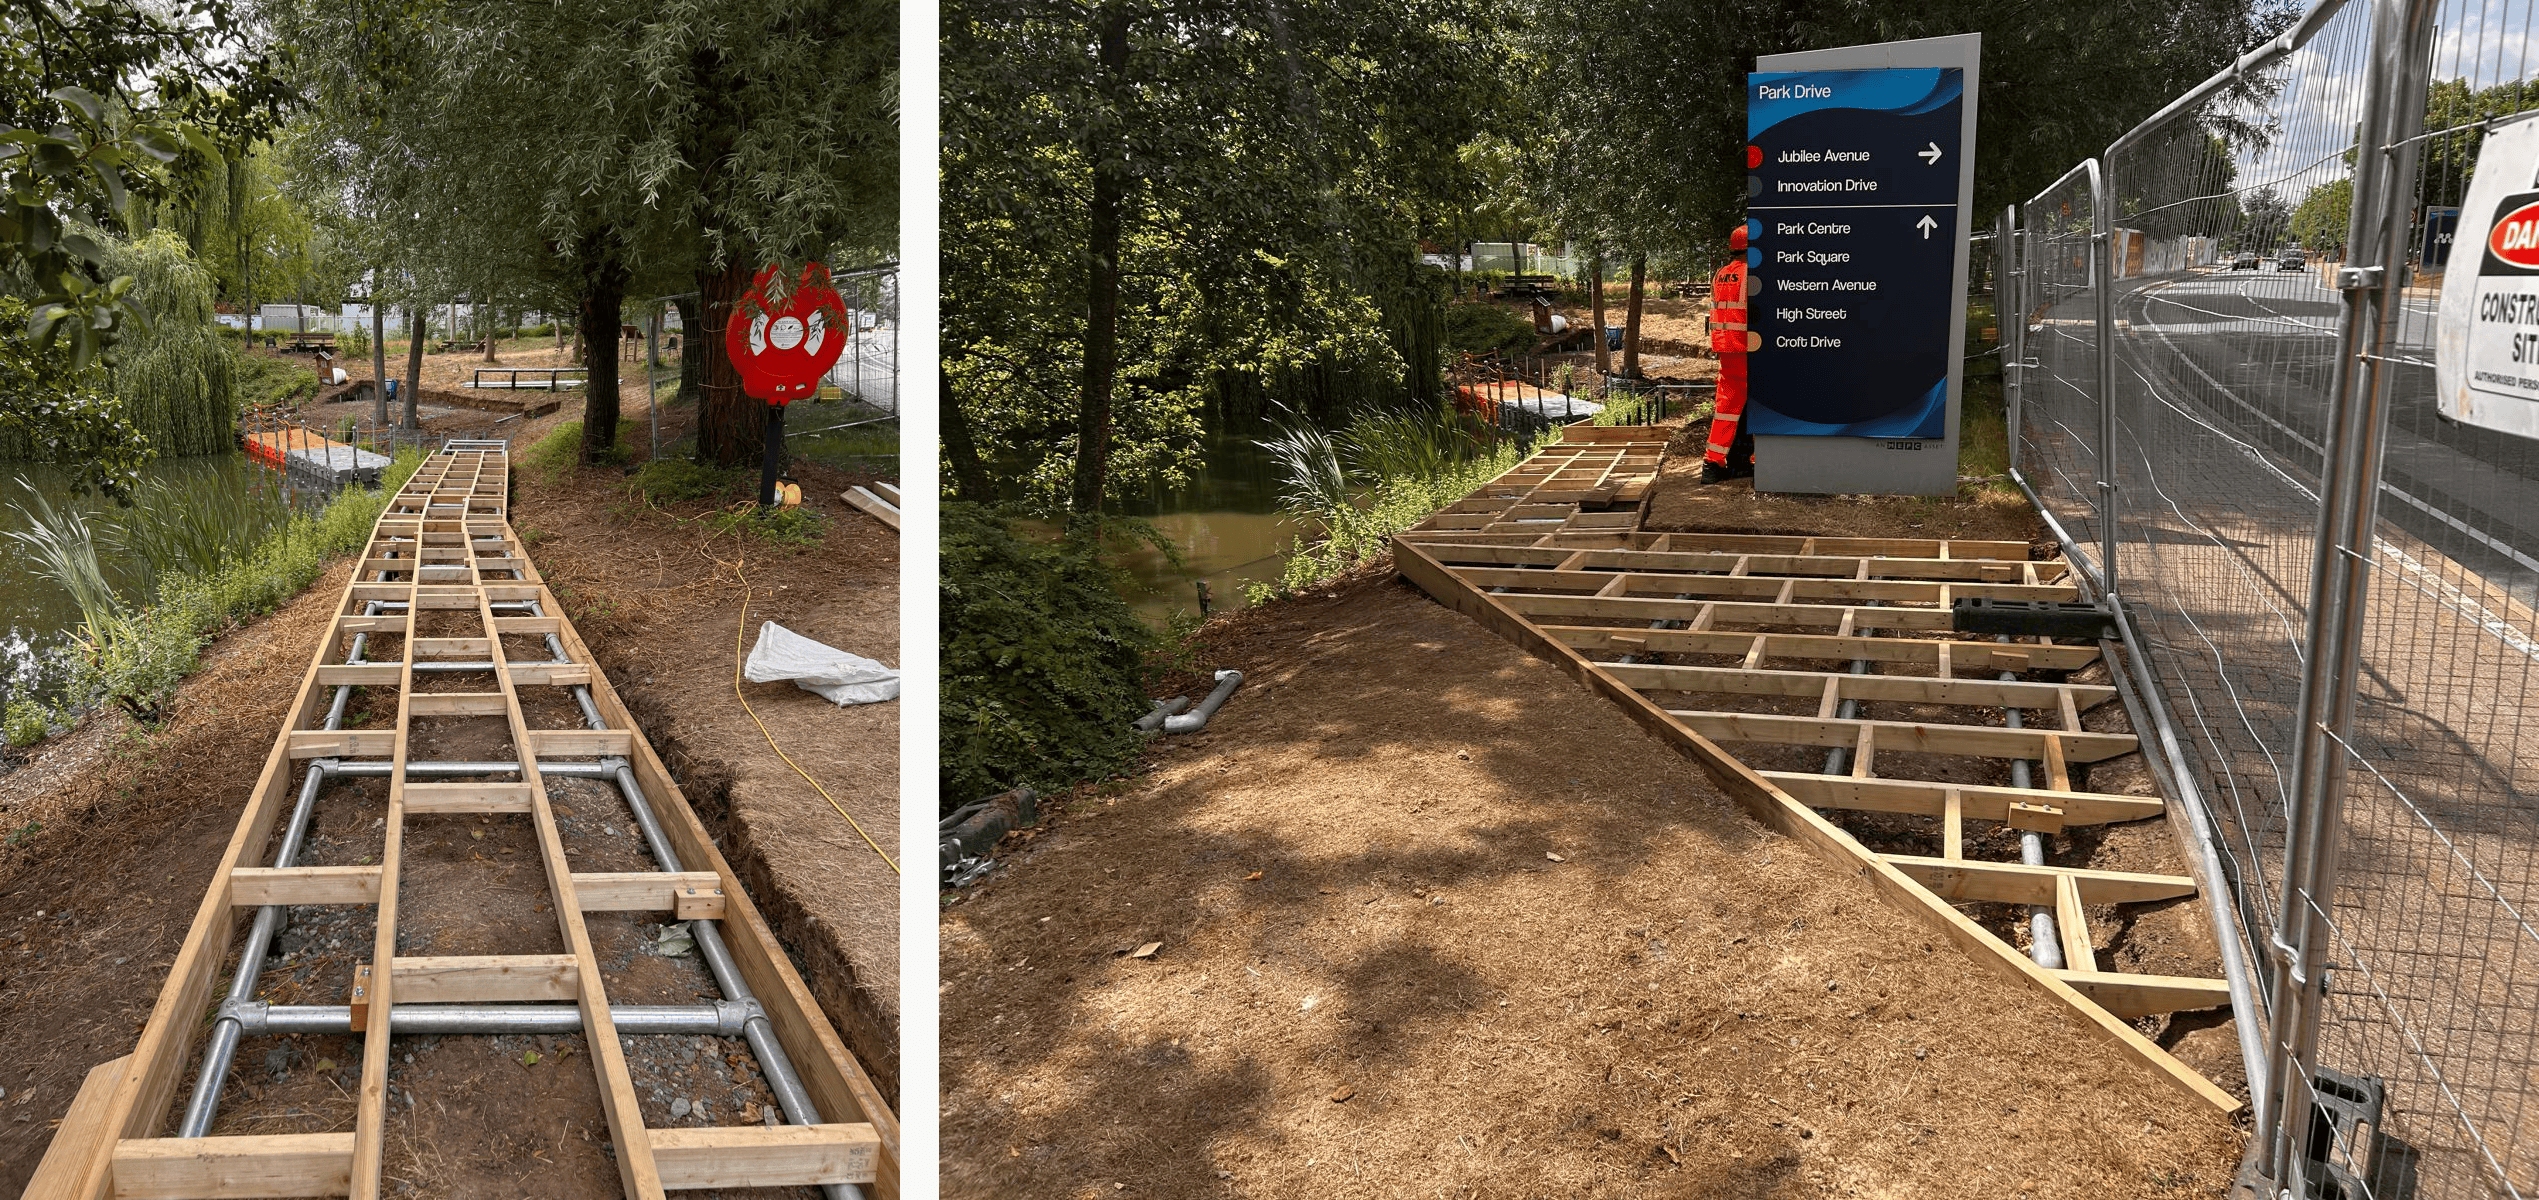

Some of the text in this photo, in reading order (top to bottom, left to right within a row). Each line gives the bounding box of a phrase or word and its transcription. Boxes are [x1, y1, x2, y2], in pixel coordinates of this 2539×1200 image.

[1759, 84, 1832, 99] Park Drive
[1777, 148, 1870, 163] Jubilee Avenue
[1777, 178, 1878, 193] Innovation Drive
[1777, 222, 1851, 235] Park Centre
[1777, 250, 1850, 266] Park Square
[1777, 279, 1877, 291] Western Avenue
[1776, 307, 1847, 323] High Street
[1776, 335, 1842, 348] Croft Drive
[2518, 377, 2539, 391] PERS
